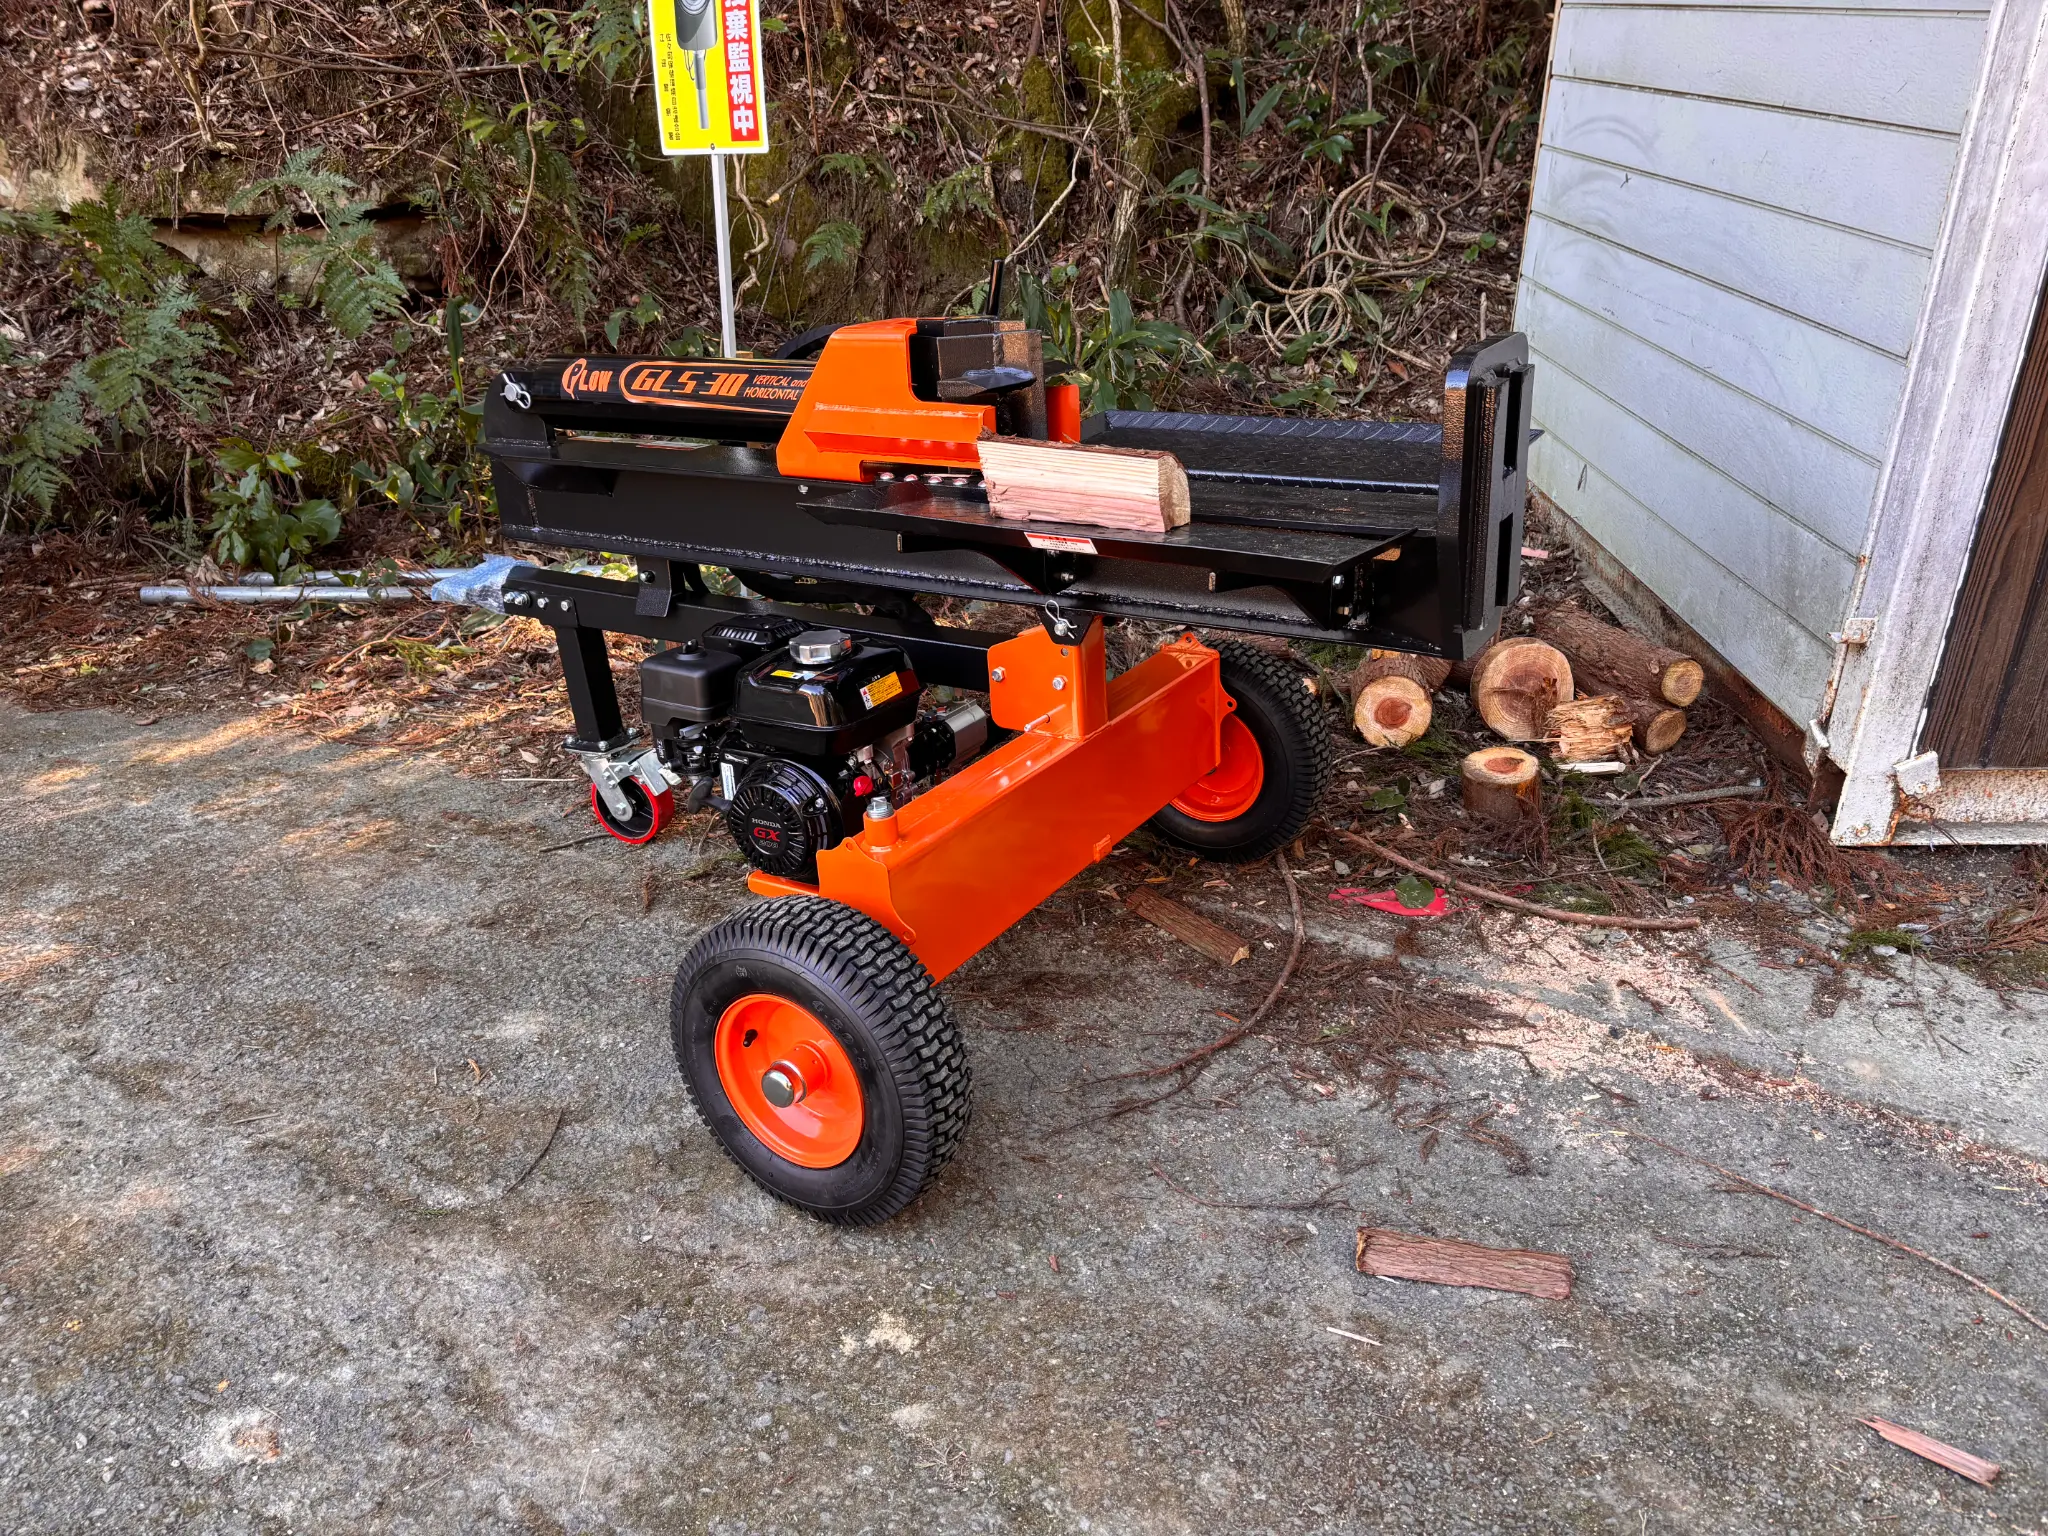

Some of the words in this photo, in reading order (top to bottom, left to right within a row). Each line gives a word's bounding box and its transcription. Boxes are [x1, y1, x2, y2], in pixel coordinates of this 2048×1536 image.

[724, 0, 754, 136] 棄監視中
[562, 358, 613, 399] PLOW
[752, 374, 789, 387] VERTICAL
[743, 386, 799, 401] HORIZONTAL
[751, 817, 782, 829] HONDA
[753, 826, 781, 842] GX
